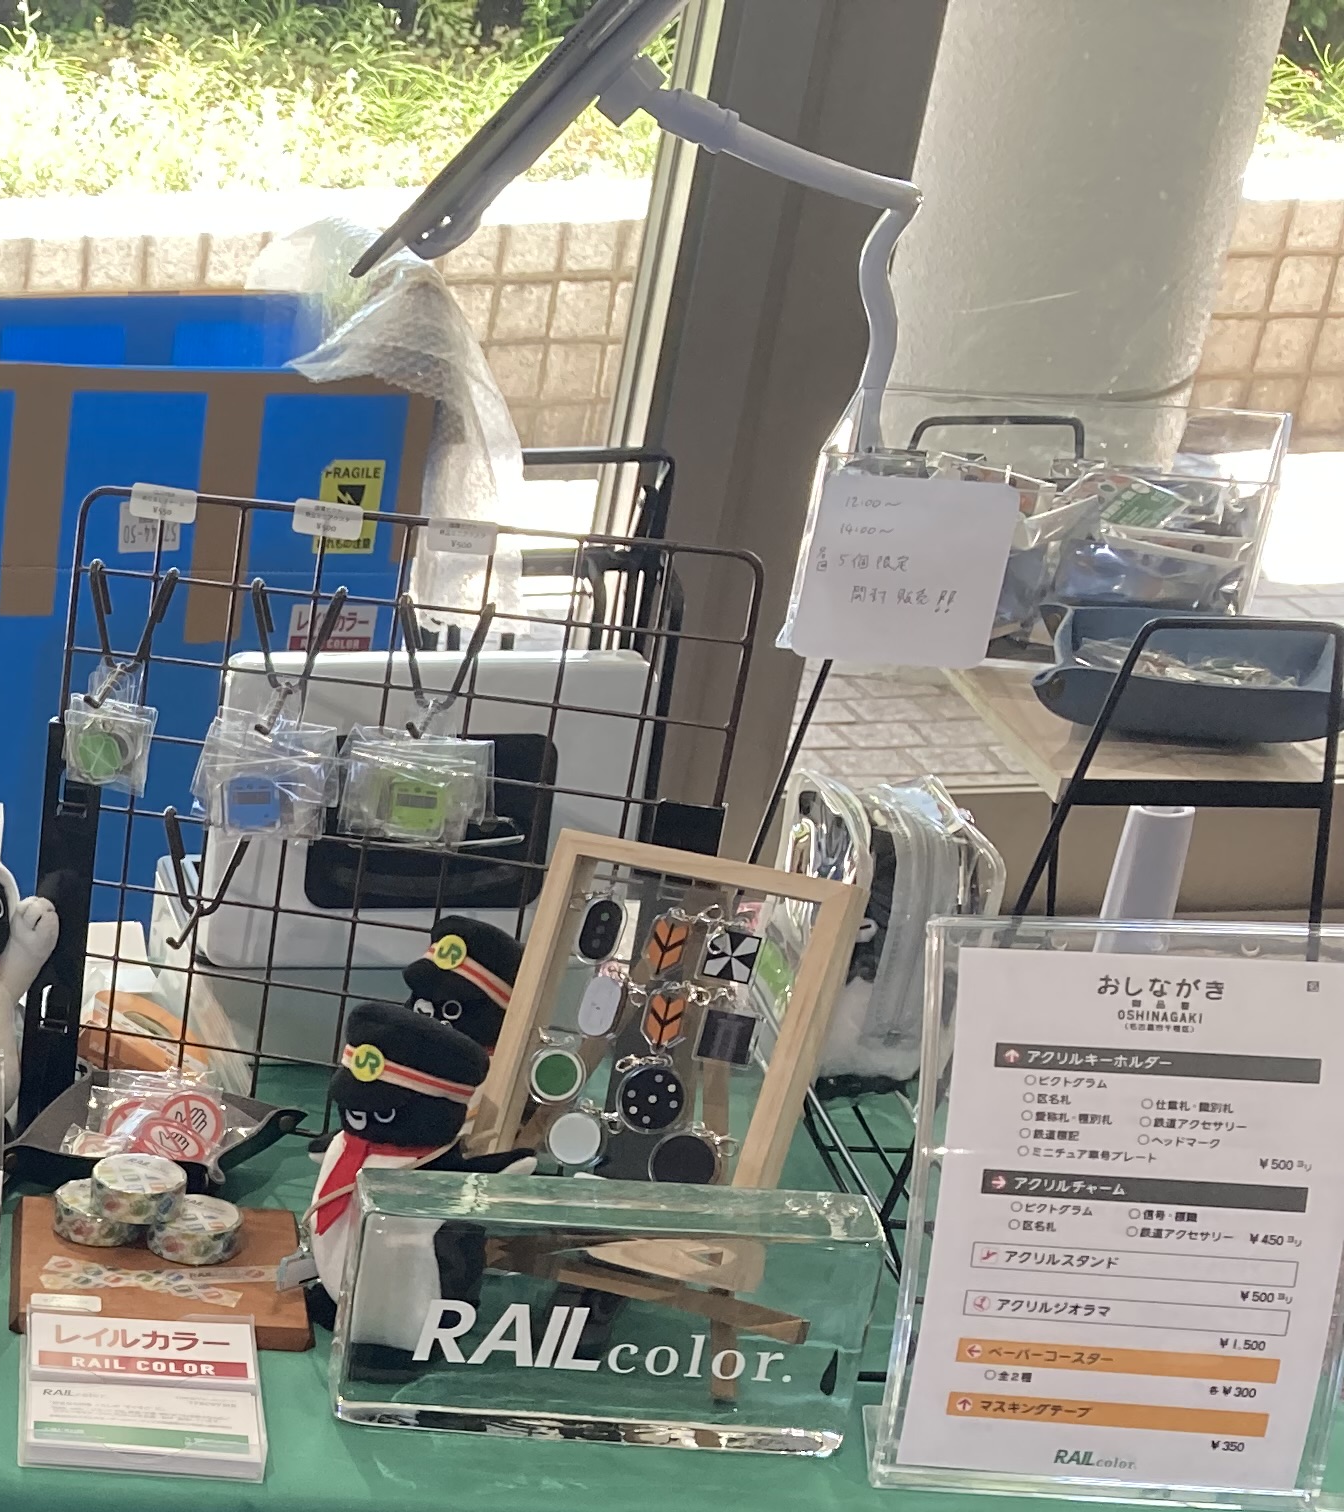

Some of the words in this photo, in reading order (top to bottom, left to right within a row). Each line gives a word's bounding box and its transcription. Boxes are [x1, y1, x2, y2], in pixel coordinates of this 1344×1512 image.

[296, 610, 369, 632] レイカラー
[1096, 974, 1225, 1000] おしながき
[1117, 1009, 1203, 1025] OSHINAGAKI
[1026, 1050, 1173, 1070] アクリルキーホルダー
[1038, 1075, 1108, 1090] ピクトグラム
[1036, 1093, 1072, 1106] 区名札
[1153, 1116, 1247, 1132] 鉄道アクセサリー
[1150, 1135, 1221, 1149] ヘッドマーク
[1259, 1157, 1294, 1171] ¥500
[1013, 1176, 1127, 1196] アクリルチャーム
[1024, 1202, 1094, 1217] ピクトグラム
[1022, 1220, 1057, 1233] 区名札
[1139, 1227, 1234, 1242] 鉄道アクセサリー
[1249, 1232, 1285, 1246] ¥450
[1004, 1249, 1121, 1270] アクリルスタンド
[1240, 1290, 1275, 1304] ¥500
[996, 1298, 1112, 1318] アクリルジオラマ
[54, 1324, 230, 1351] レイルカラー
[412, 1301, 607, 1372] RAIL
[607, 1334, 793, 1384] color.
[988, 1346, 1115, 1366] ペーパーコースター
[71, 1356, 126, 1371] RAIL
[136, 1360, 216, 1376] COLOR
[42, 1388, 74, 1397] RAIL
[1222, 1385, 1257, 1399] ¥300
[980, 1399, 1093, 1419] マスキングテープ
[1210, 1438, 1245, 1453] ¥350
[1053, 1448, 1095, 1467] RAIL
